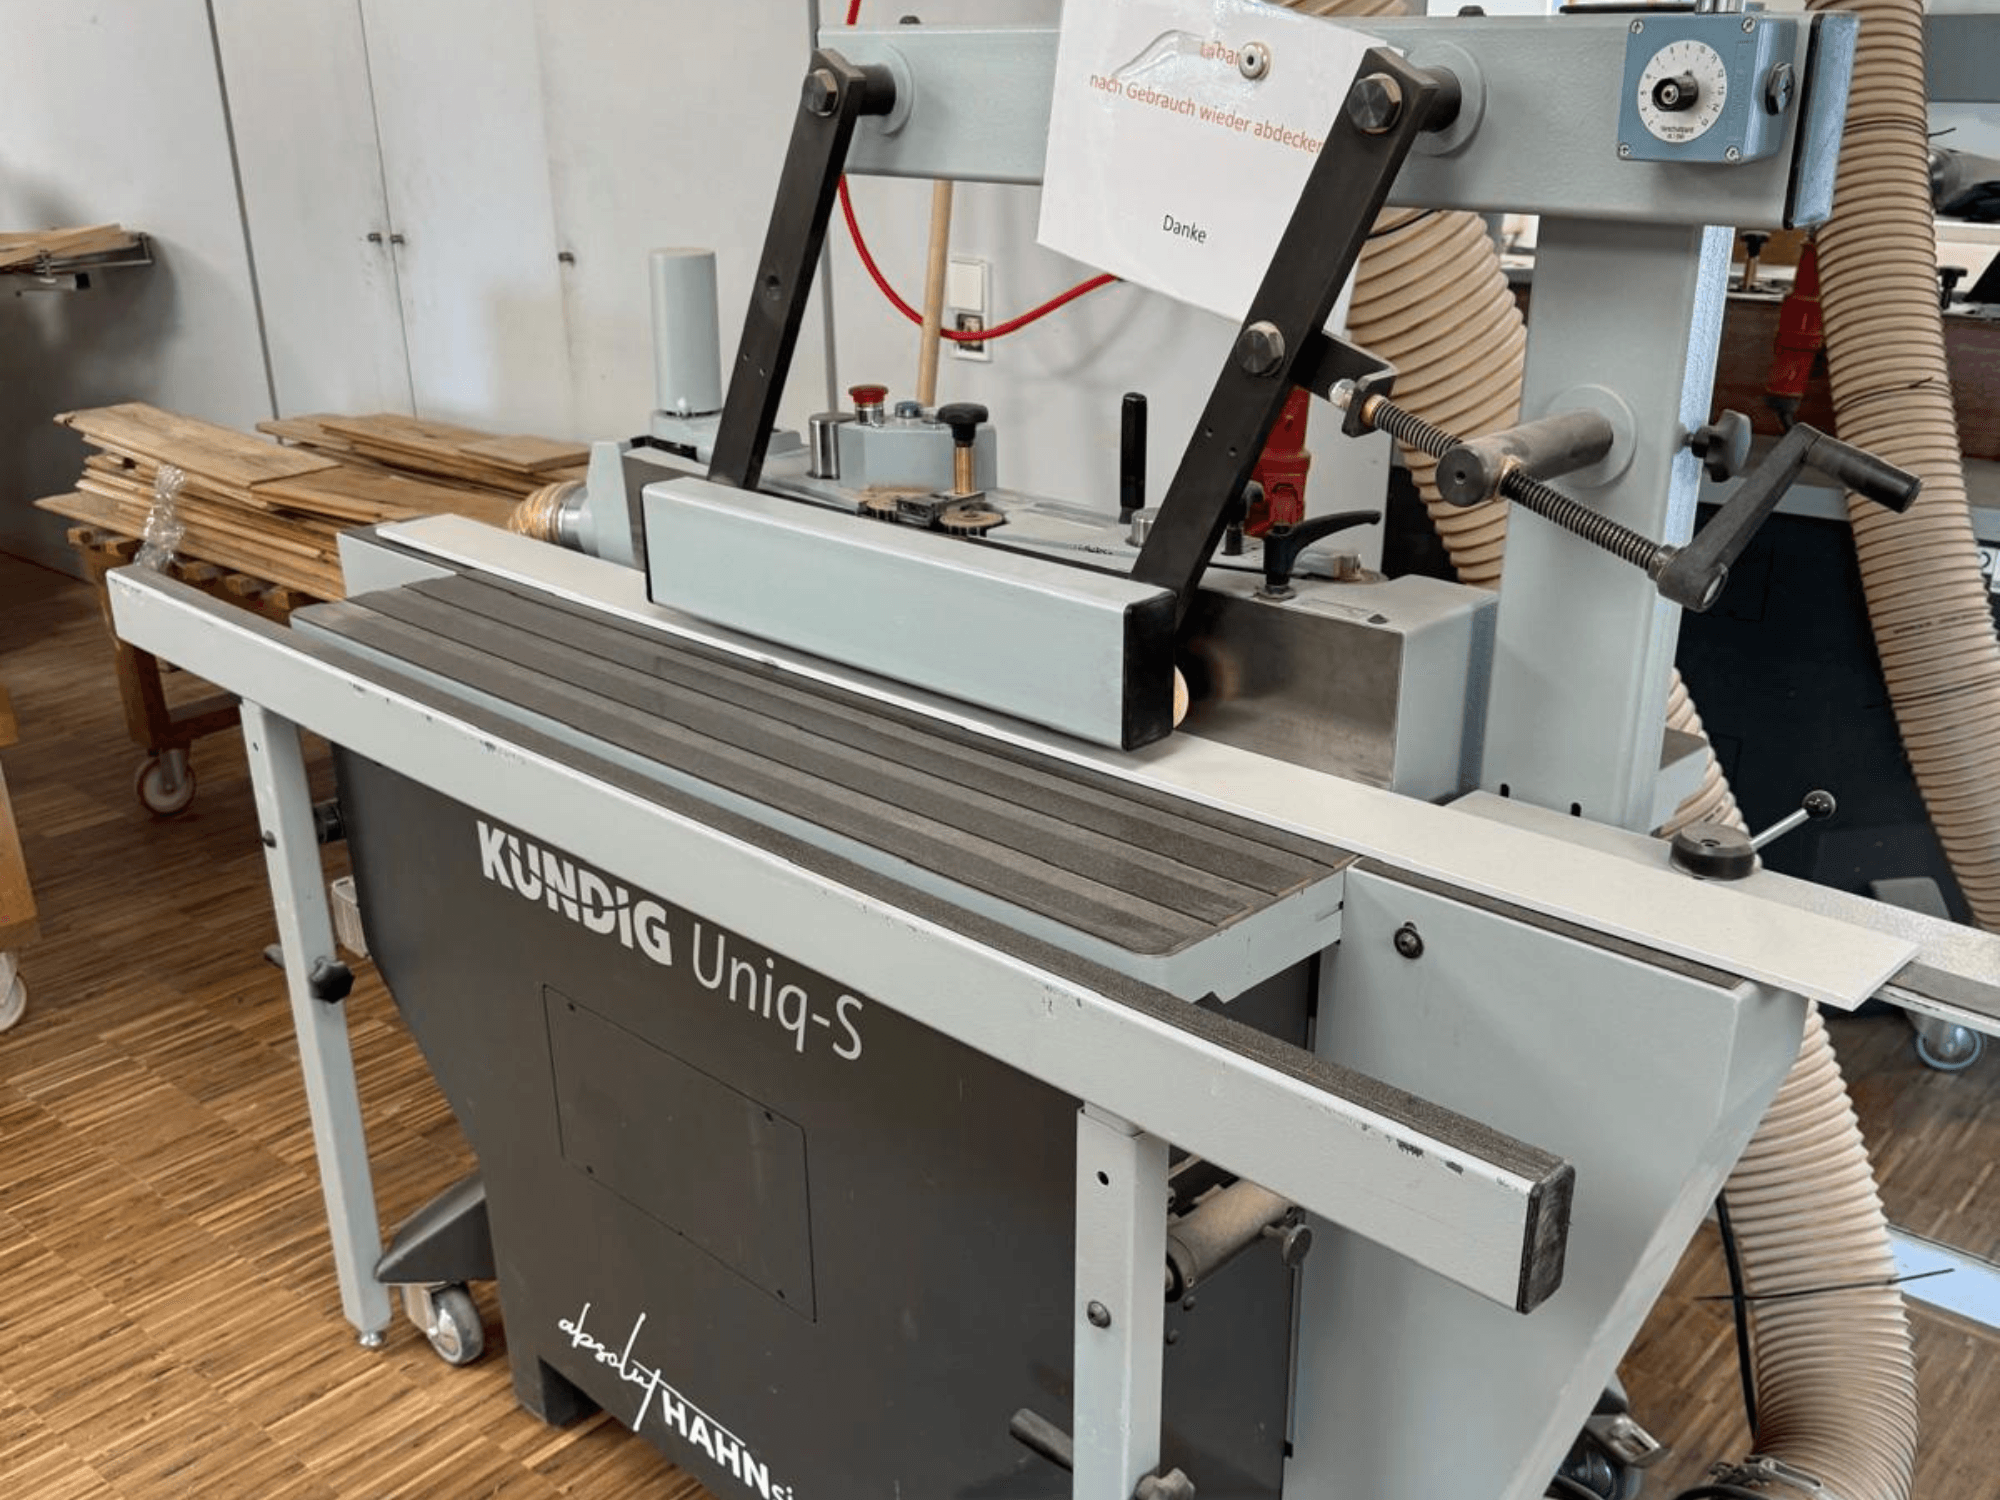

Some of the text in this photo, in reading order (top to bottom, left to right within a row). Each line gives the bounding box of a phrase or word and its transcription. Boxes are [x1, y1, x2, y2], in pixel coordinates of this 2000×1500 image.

[1090, 73, 1123, 95] nach
[1126, 81, 1196, 117] Gebrauch
[1199, 104, 1252, 133] wieder
[1162, 213, 1207, 244] Danke
[692, 922, 864, 1061] Uniq-S
